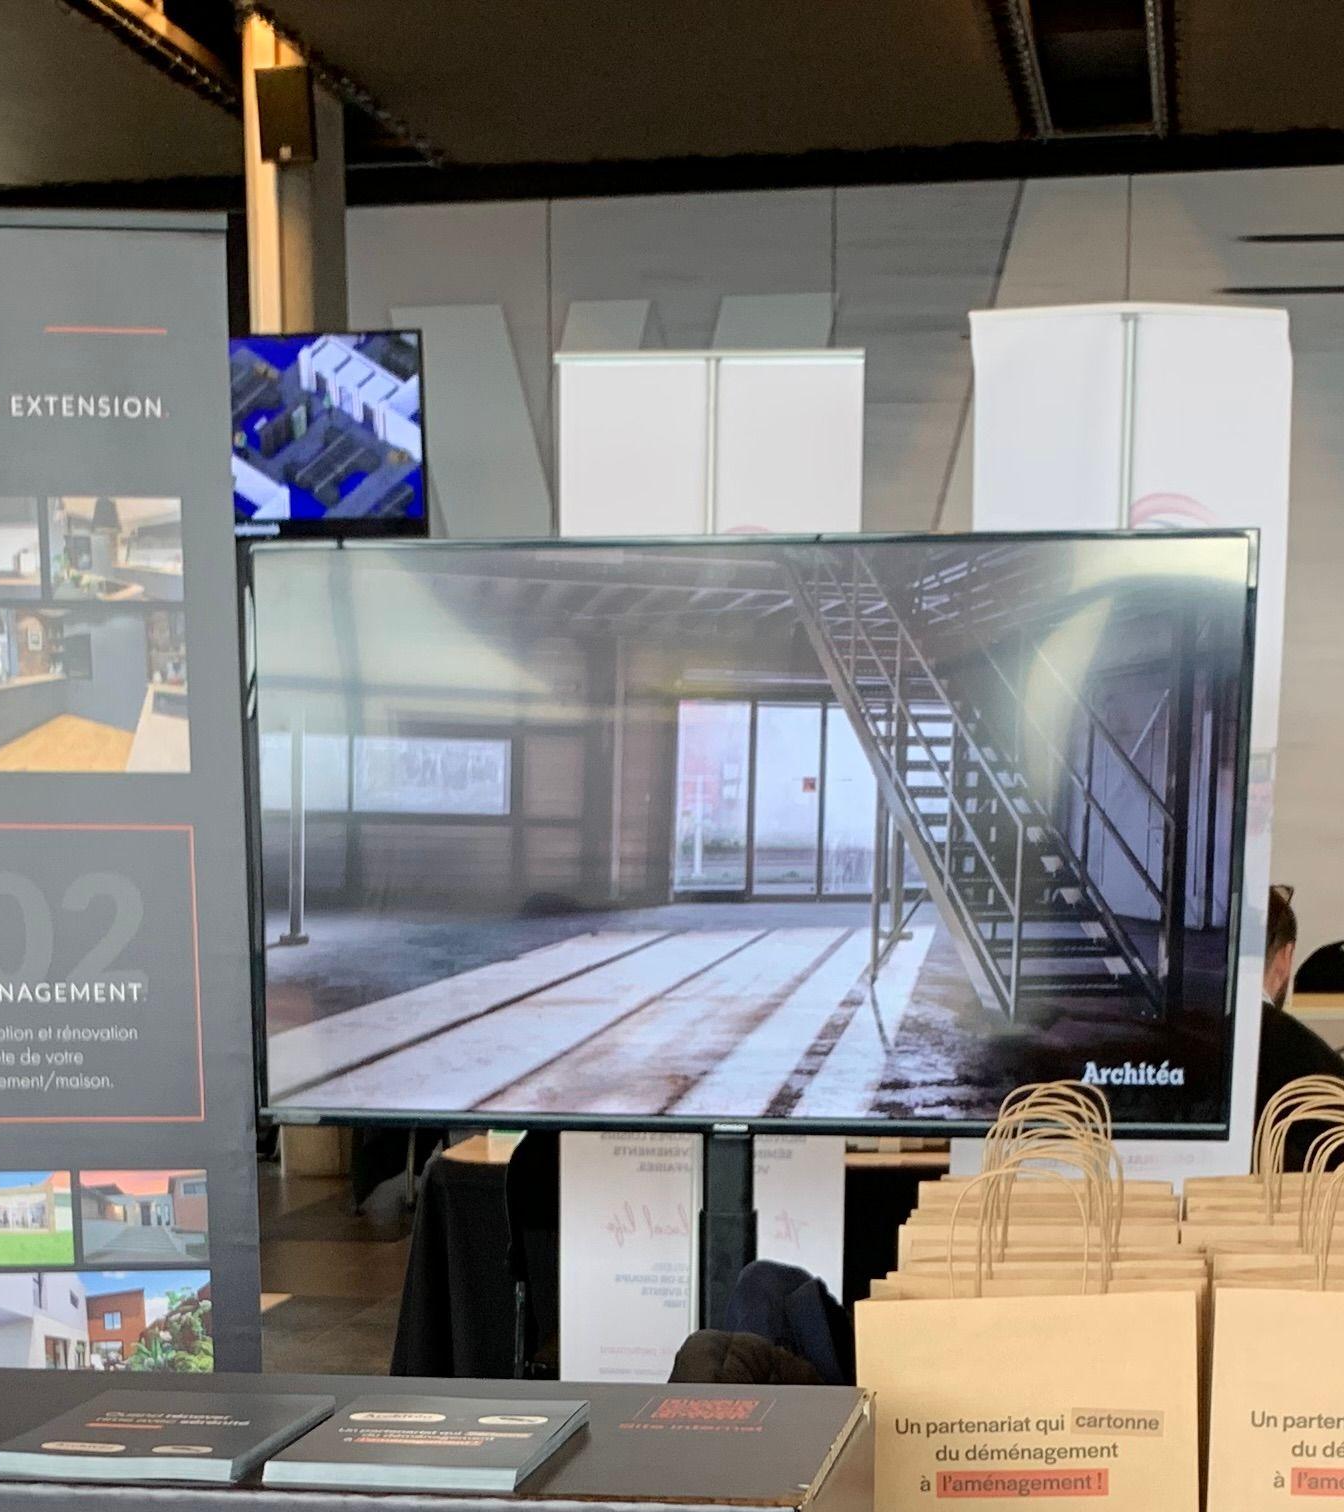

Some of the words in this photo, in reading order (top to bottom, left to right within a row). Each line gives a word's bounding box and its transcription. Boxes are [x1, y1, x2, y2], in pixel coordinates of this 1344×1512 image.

[37, 1023, 53, 1042] et
[56, 1023, 139, 1043] rénovation
[20, 1047, 41, 1066] de
[45, 1049, 84, 1066] votre
[1080, 1060, 1185, 1089] Architéa
[895, 1417, 921, 1435] Un
[926, 1415, 1031, 1438] partenariat
[1036, 1414, 1065, 1437] qui
[1075, 1412, 1159, 1431] cartonne
[1251, 1410, 1278, 1428] Un
[936, 1445, 959, 1461] du
[965, 1441, 1119, 1465] déménagement
[1291, 1440, 1317, 1458] du
[920, 1475, 931, 1492] à
[942, 1472, 1092, 1496] l'aménagement
[1273, 1471, 1285, 1489] à
